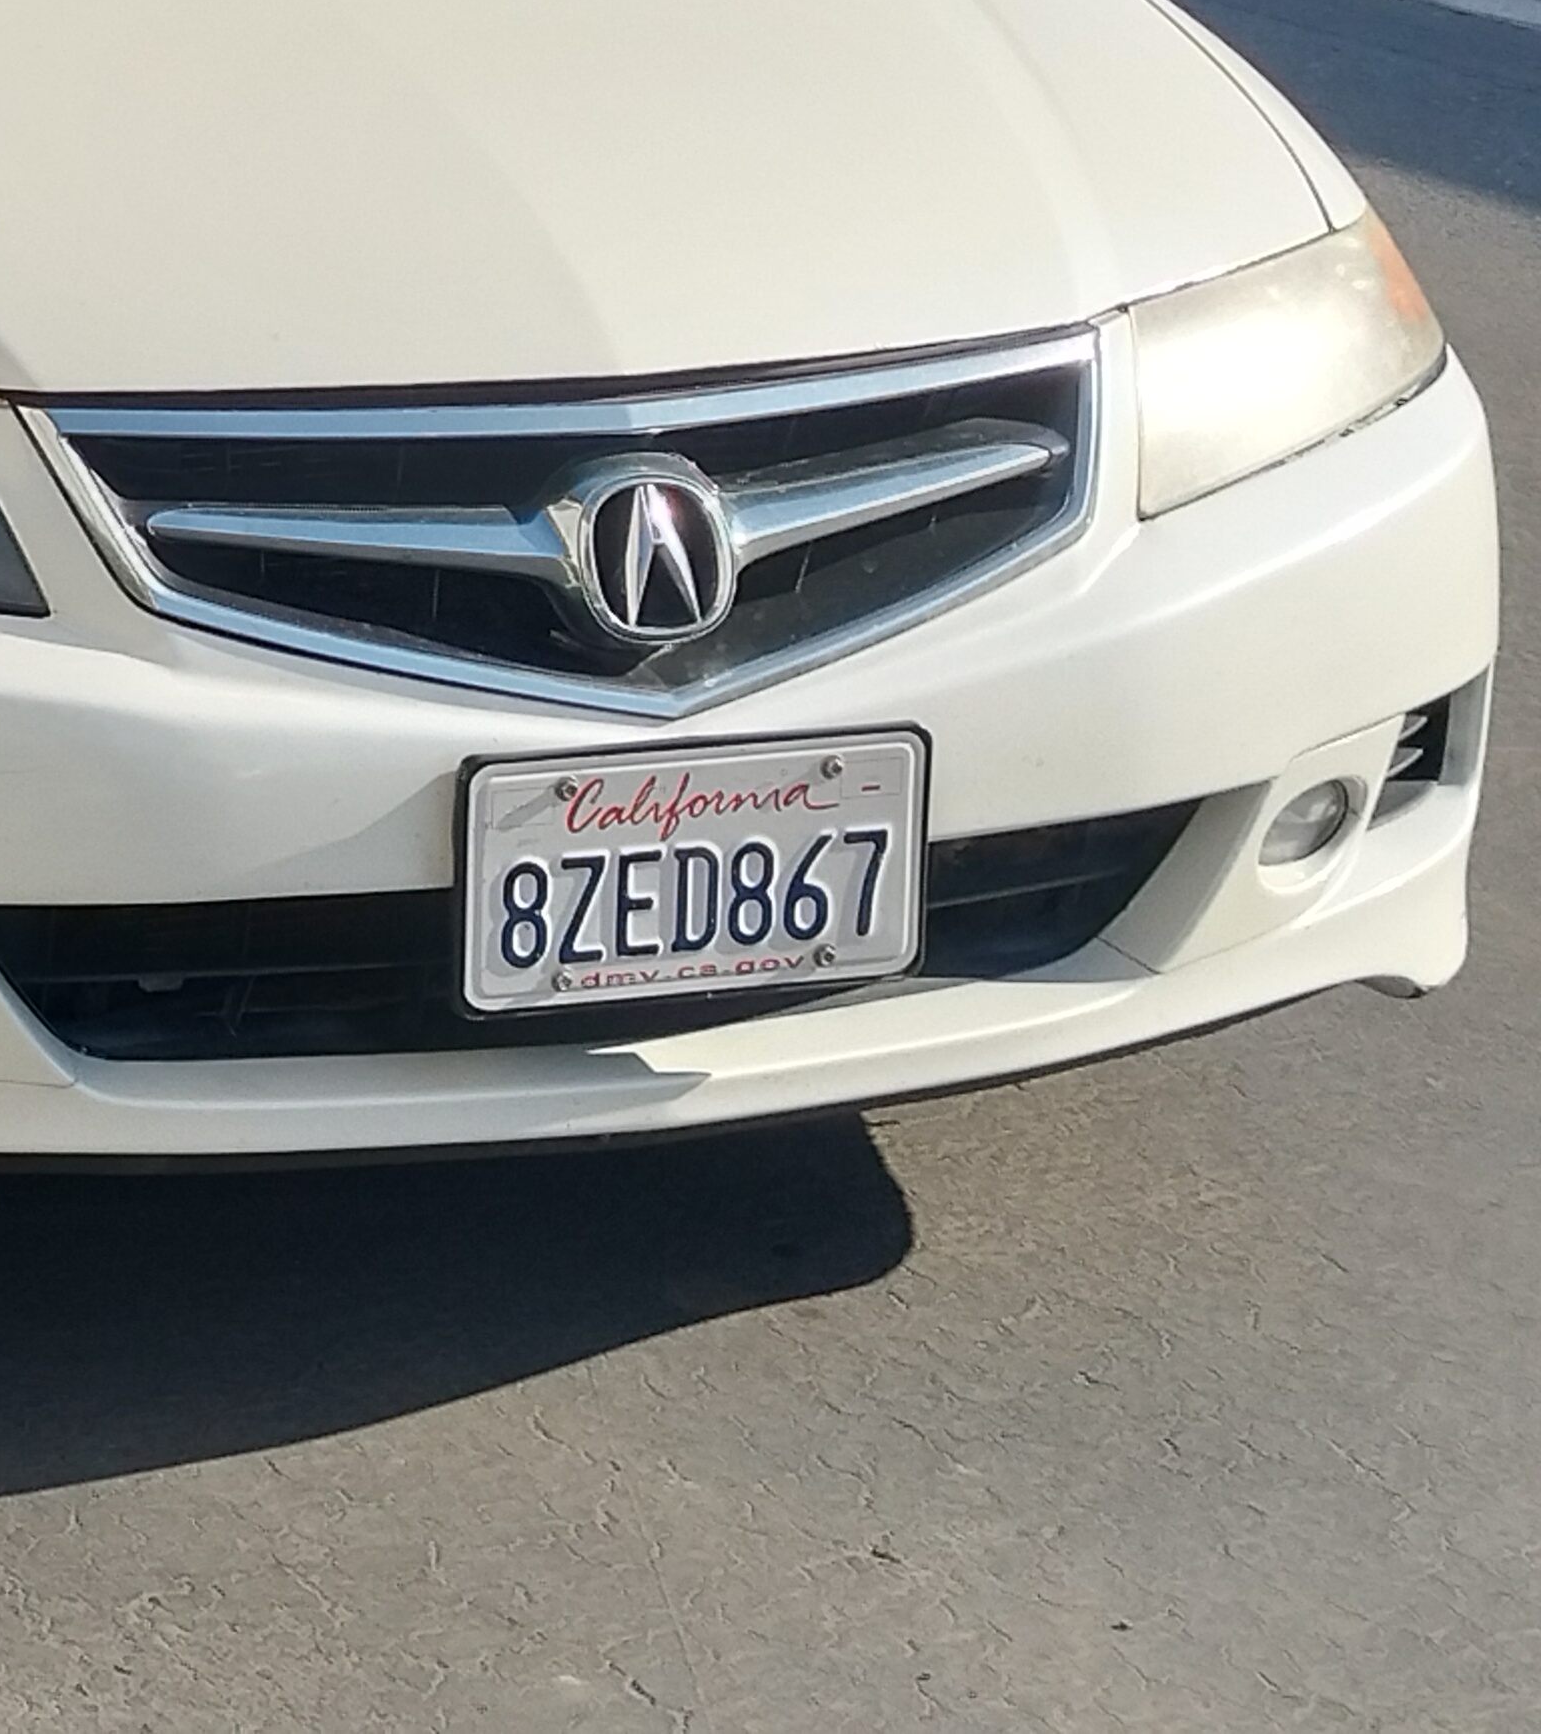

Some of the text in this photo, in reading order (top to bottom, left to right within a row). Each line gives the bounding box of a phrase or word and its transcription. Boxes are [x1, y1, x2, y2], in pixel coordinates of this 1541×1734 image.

[565, 771, 840, 843] California
[500, 828, 890, 969] 8ZED867
[579, 955, 806, 989] dmv.ca.gov
